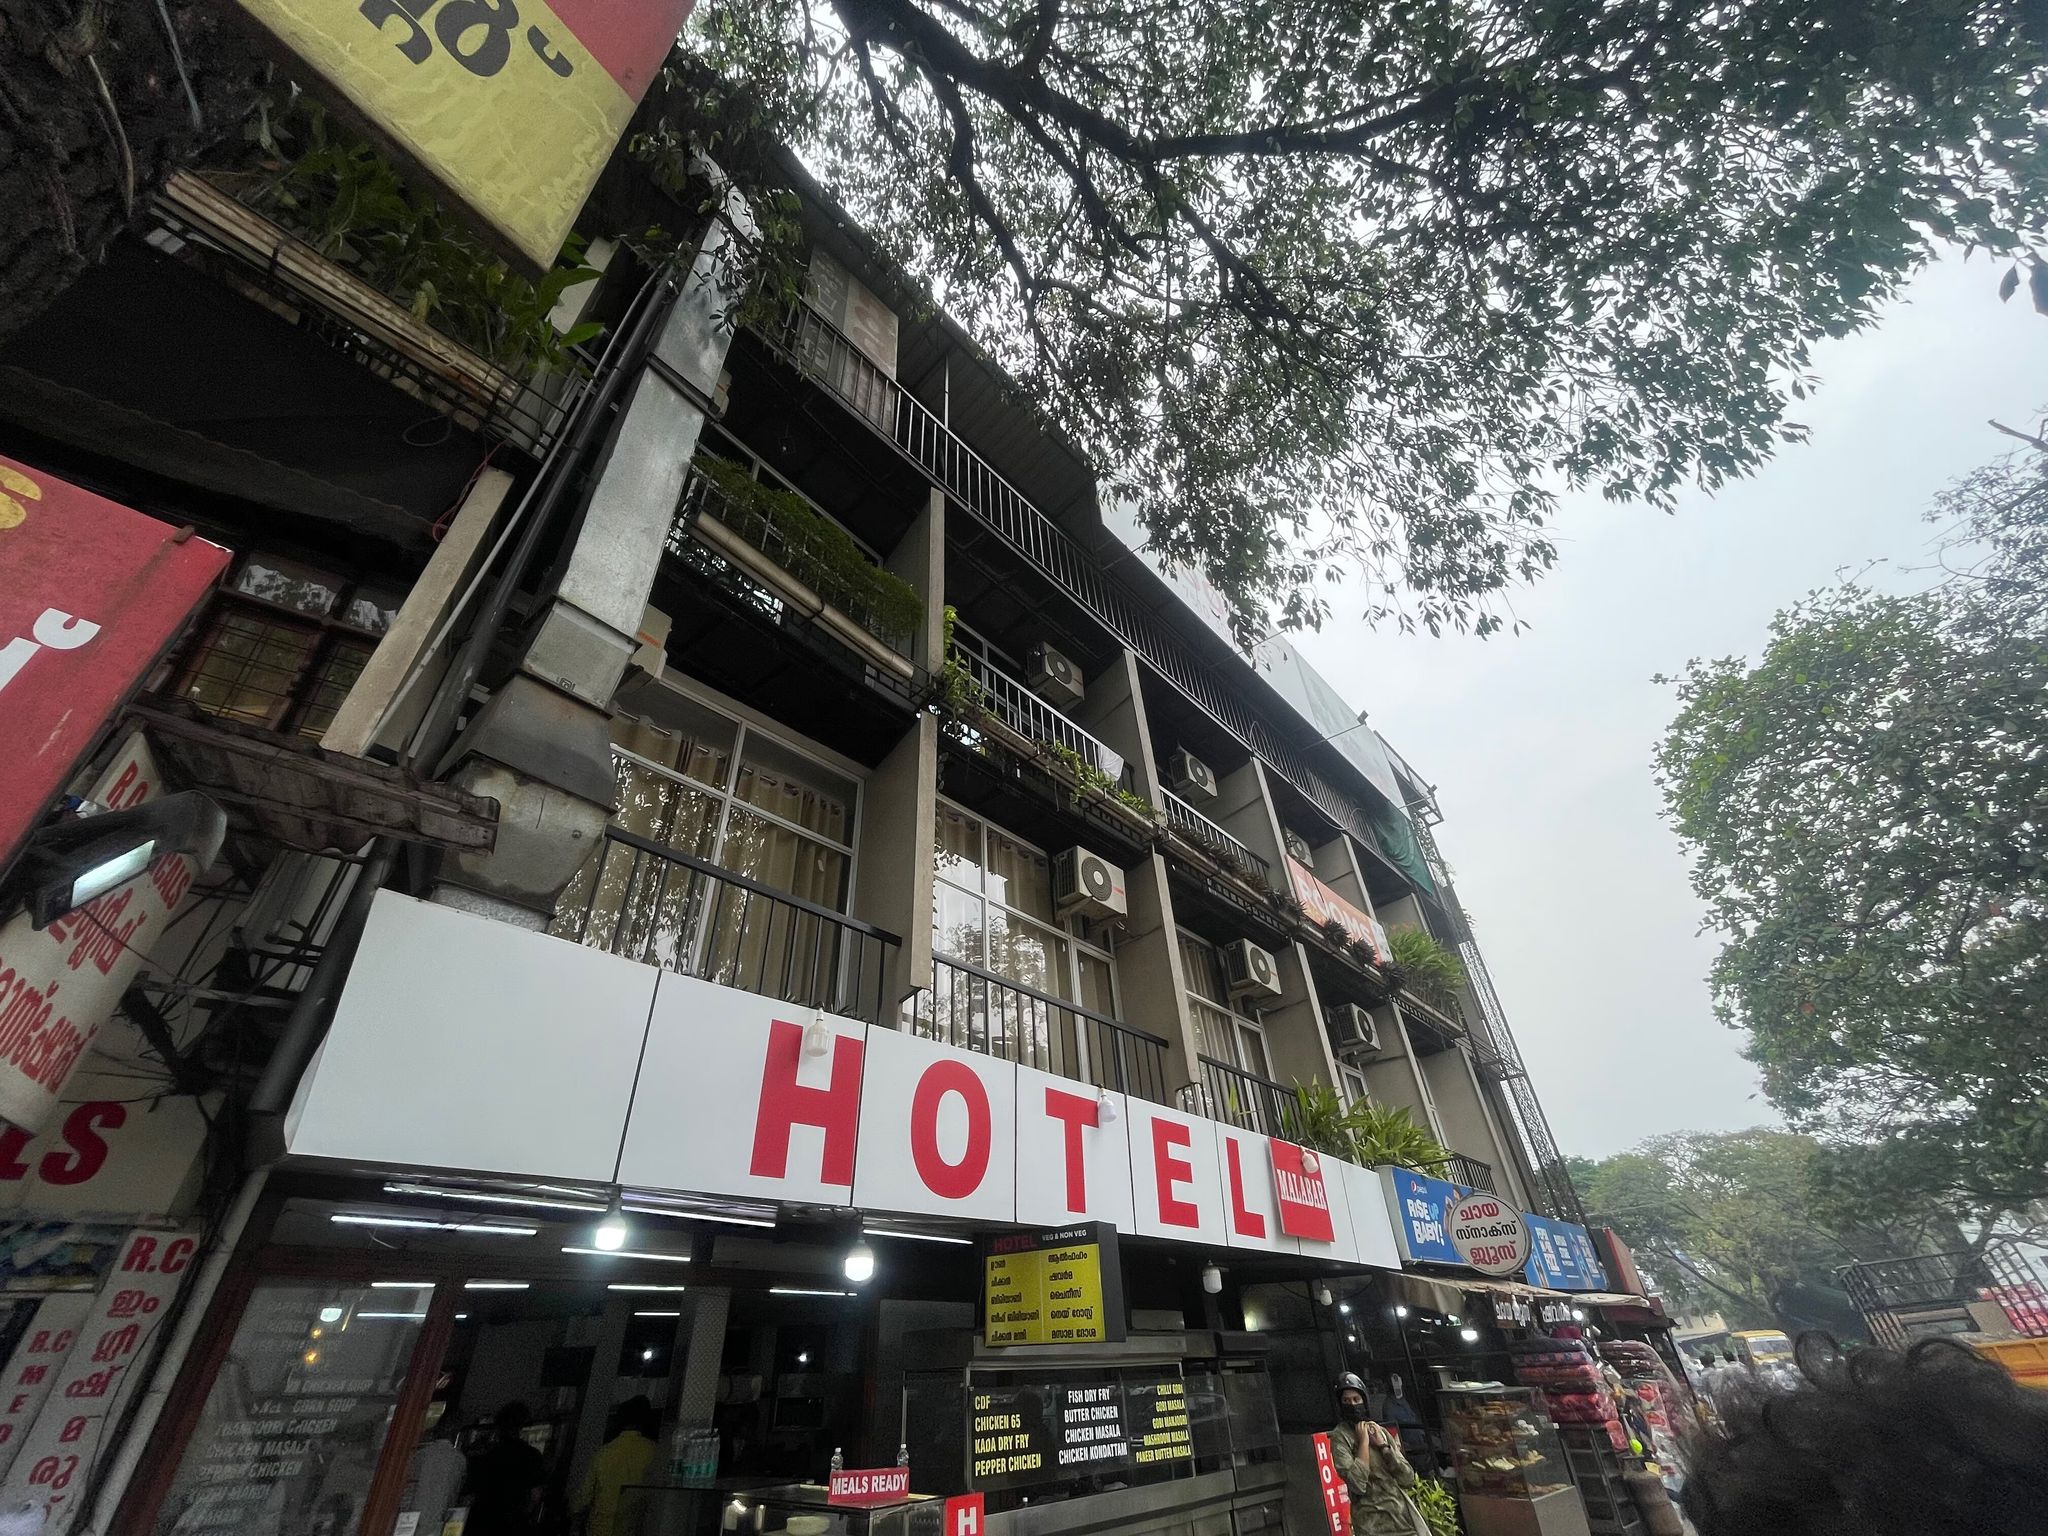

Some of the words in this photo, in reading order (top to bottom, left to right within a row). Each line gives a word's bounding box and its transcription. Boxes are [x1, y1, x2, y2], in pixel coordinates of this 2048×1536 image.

[750, 1019, 1265, 1239] HOTEL
[1276, 1168, 1327, 1211] MALABAR
[1407, 1199, 1431, 1221] RISE
[1428, 1203, 1440, 1221] UP
[1460, 1202, 1499, 1221] ചായ
[1060, 1231, 1073, 1239] NON
[1074, 1229, 1087, 1237] VEG
[1412, 1220, 1445, 1246] BABY!
[1456, 1220, 1517, 1240] സ്നാക്സ്
[121, 1236, 194, 1273] R.C
[1470, 1240, 1517, 1265] ജ്യൂസ്
[975, 1395, 990, 1410] CDF
[1068, 1390, 1083, 1403] FISH
[1084, 1389, 1097, 1402] DRY
[1098, 1388, 1110, 1400] FRY
[975, 1414, 1009, 1432] CHICKEN
[1011, 1414, 1021, 1428] 65
[1064, 1408, 1090, 1423] BUTTER
[1091, 1406, 1118, 1420] CHICKEN
[998, 1435, 1013, 1451] DRY
[1015, 1433, 1029, 1449] FRY
[1065, 1427, 1094, 1443] CHICKEN
[1095, 1424, 1121, 1440] MASALA
[1059, 1446, 1089, 1464] CHICKEN
[975, 1458, 1007, 1477] PEPPER
[1008, 1453, 1041, 1472] CHICKEN
[831, 1474, 868, 1495] MEALS
[871, 1472, 908, 1493] READY
